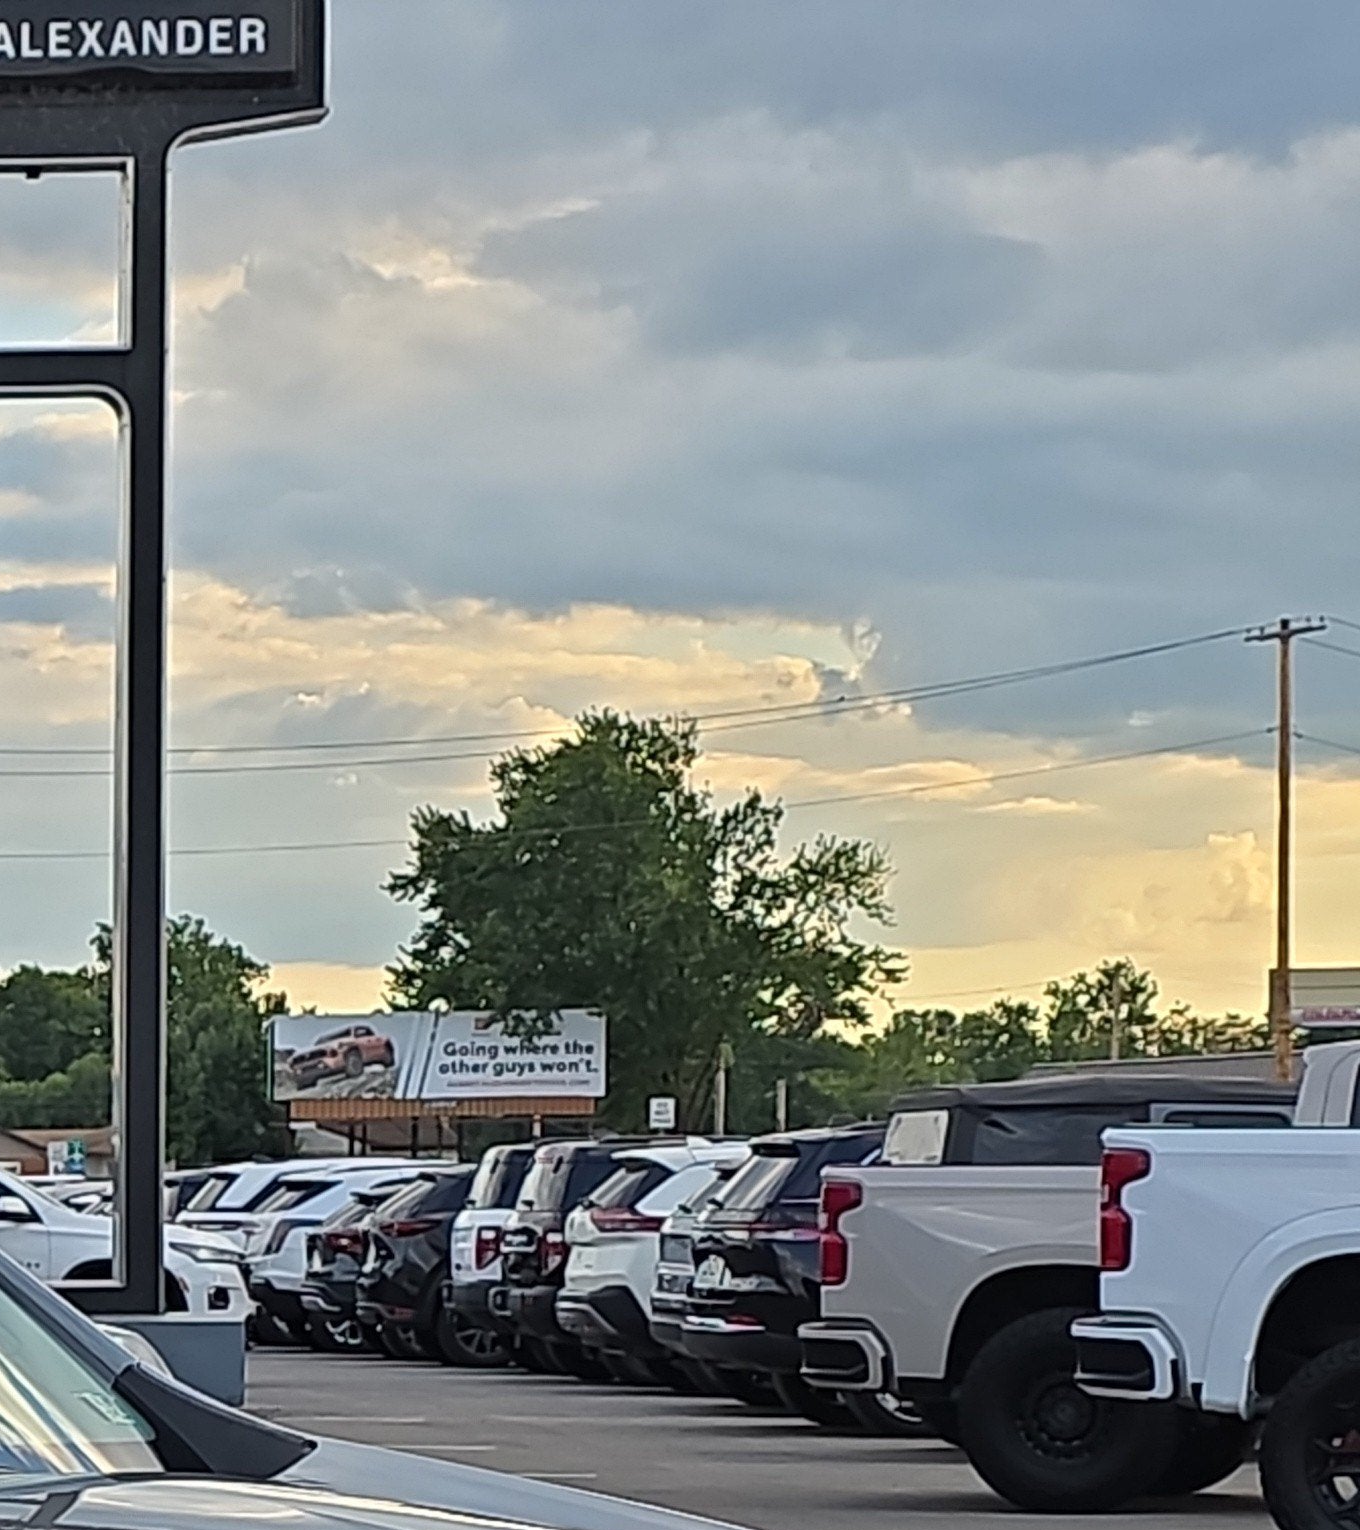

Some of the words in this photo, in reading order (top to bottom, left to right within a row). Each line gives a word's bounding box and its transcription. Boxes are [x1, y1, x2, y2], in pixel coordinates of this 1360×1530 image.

[443, 1041, 499, 1060] Going
[503, 1039, 560, 1055] where
[565, 1039, 595, 1055] the
[438, 1059, 488, 1075] other
[493, 1061, 536, 1077] guys
